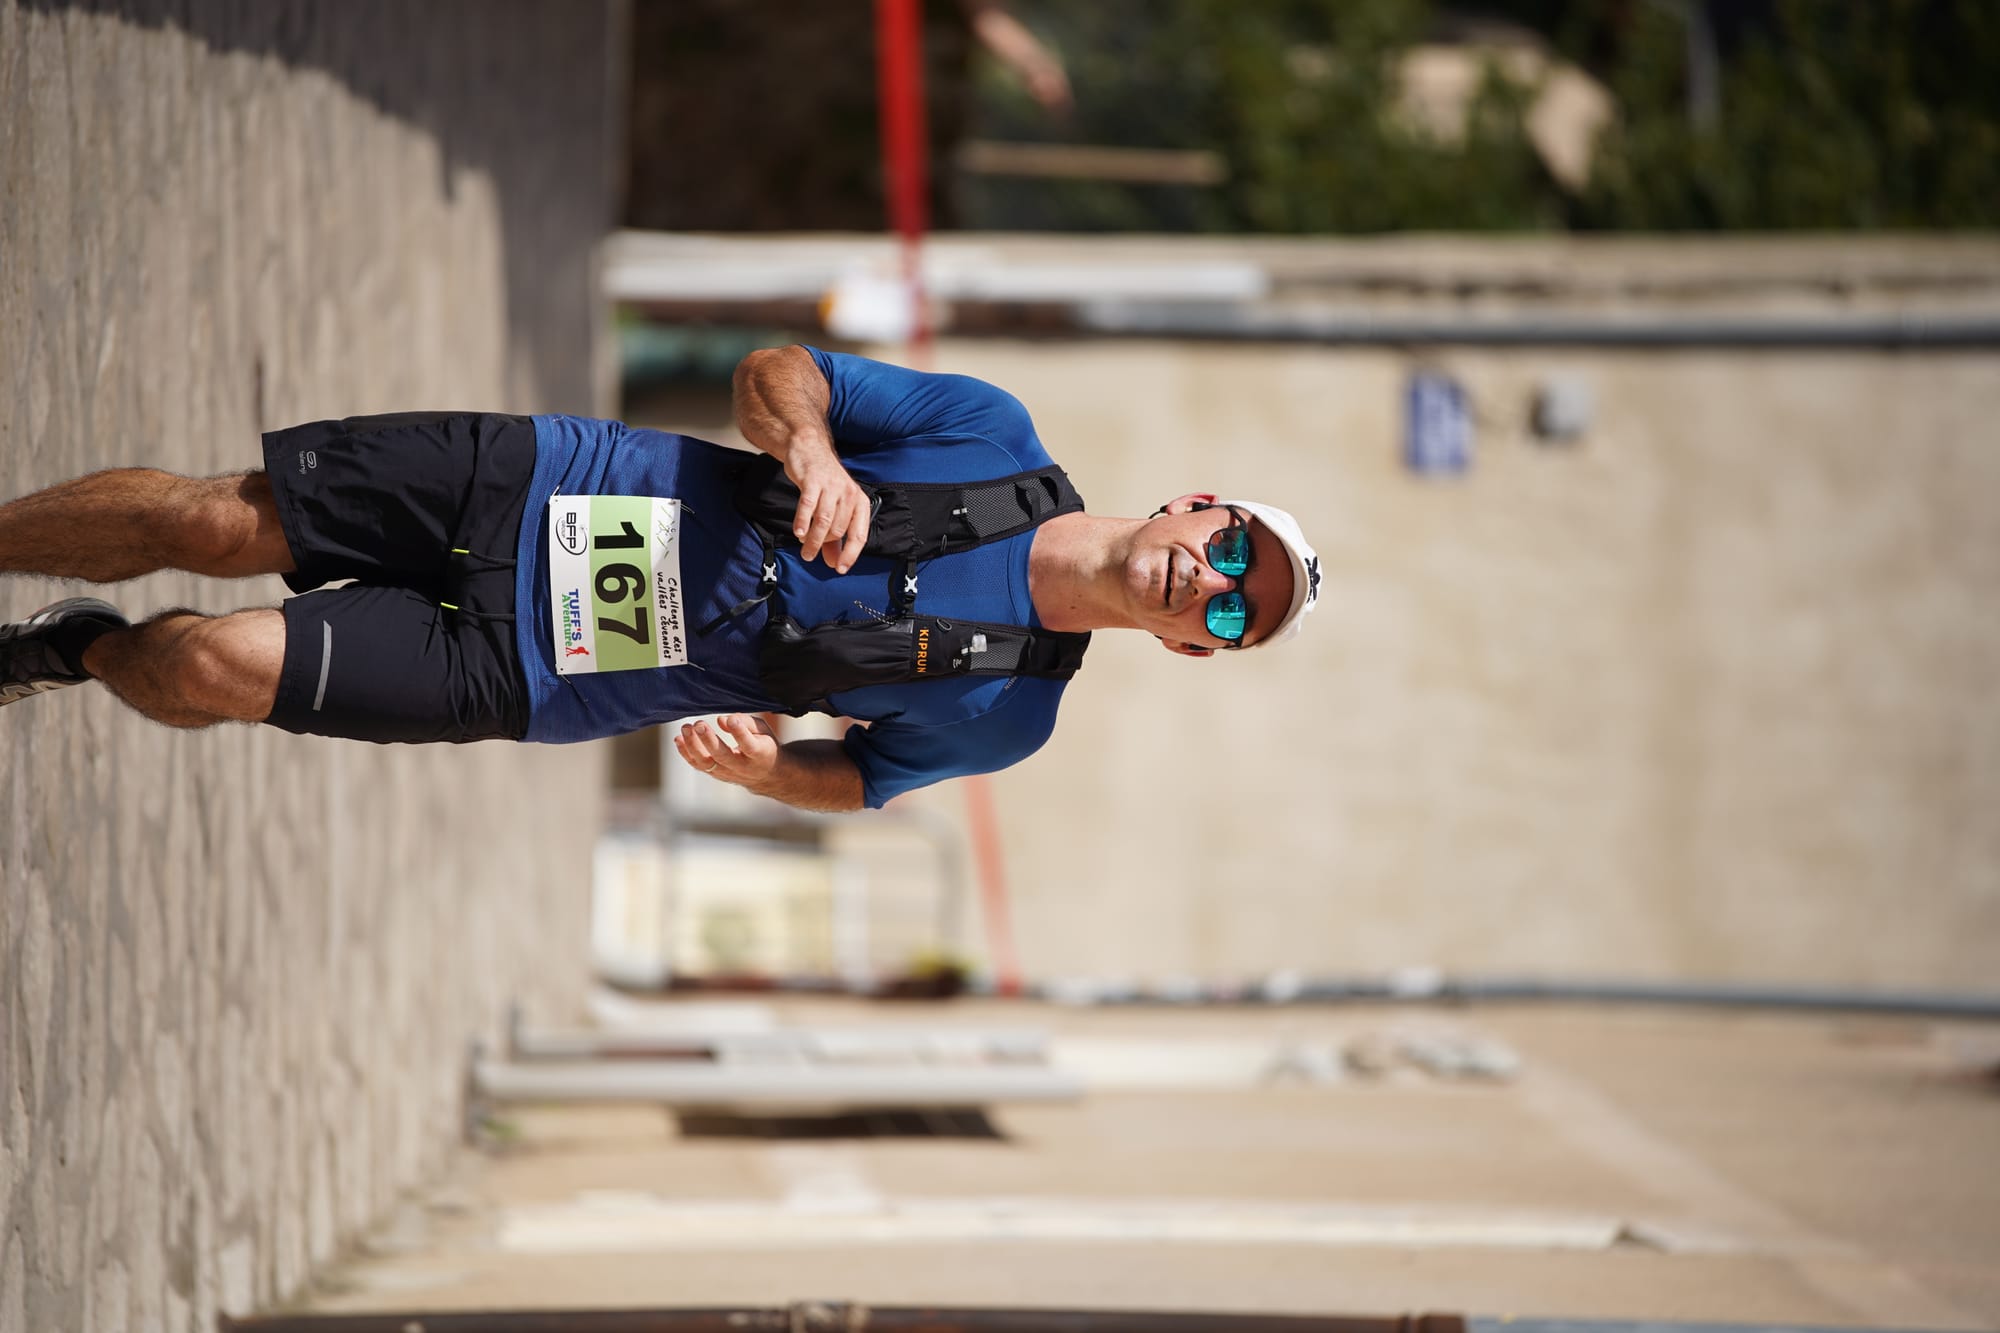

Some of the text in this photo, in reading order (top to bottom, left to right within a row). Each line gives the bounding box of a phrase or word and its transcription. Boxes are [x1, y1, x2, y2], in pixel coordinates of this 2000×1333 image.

[566, 512, 577, 549] BFP
[593, 521, 650, 645] 167
[561, 593, 572, 647] Aventure
[568, 588, 582, 641] TUFF'S
[657, 571, 672, 659] vallées cévenoles
[668, 577, 682, 653] Challenge des
[916, 628, 930, 673] KIPRUN
